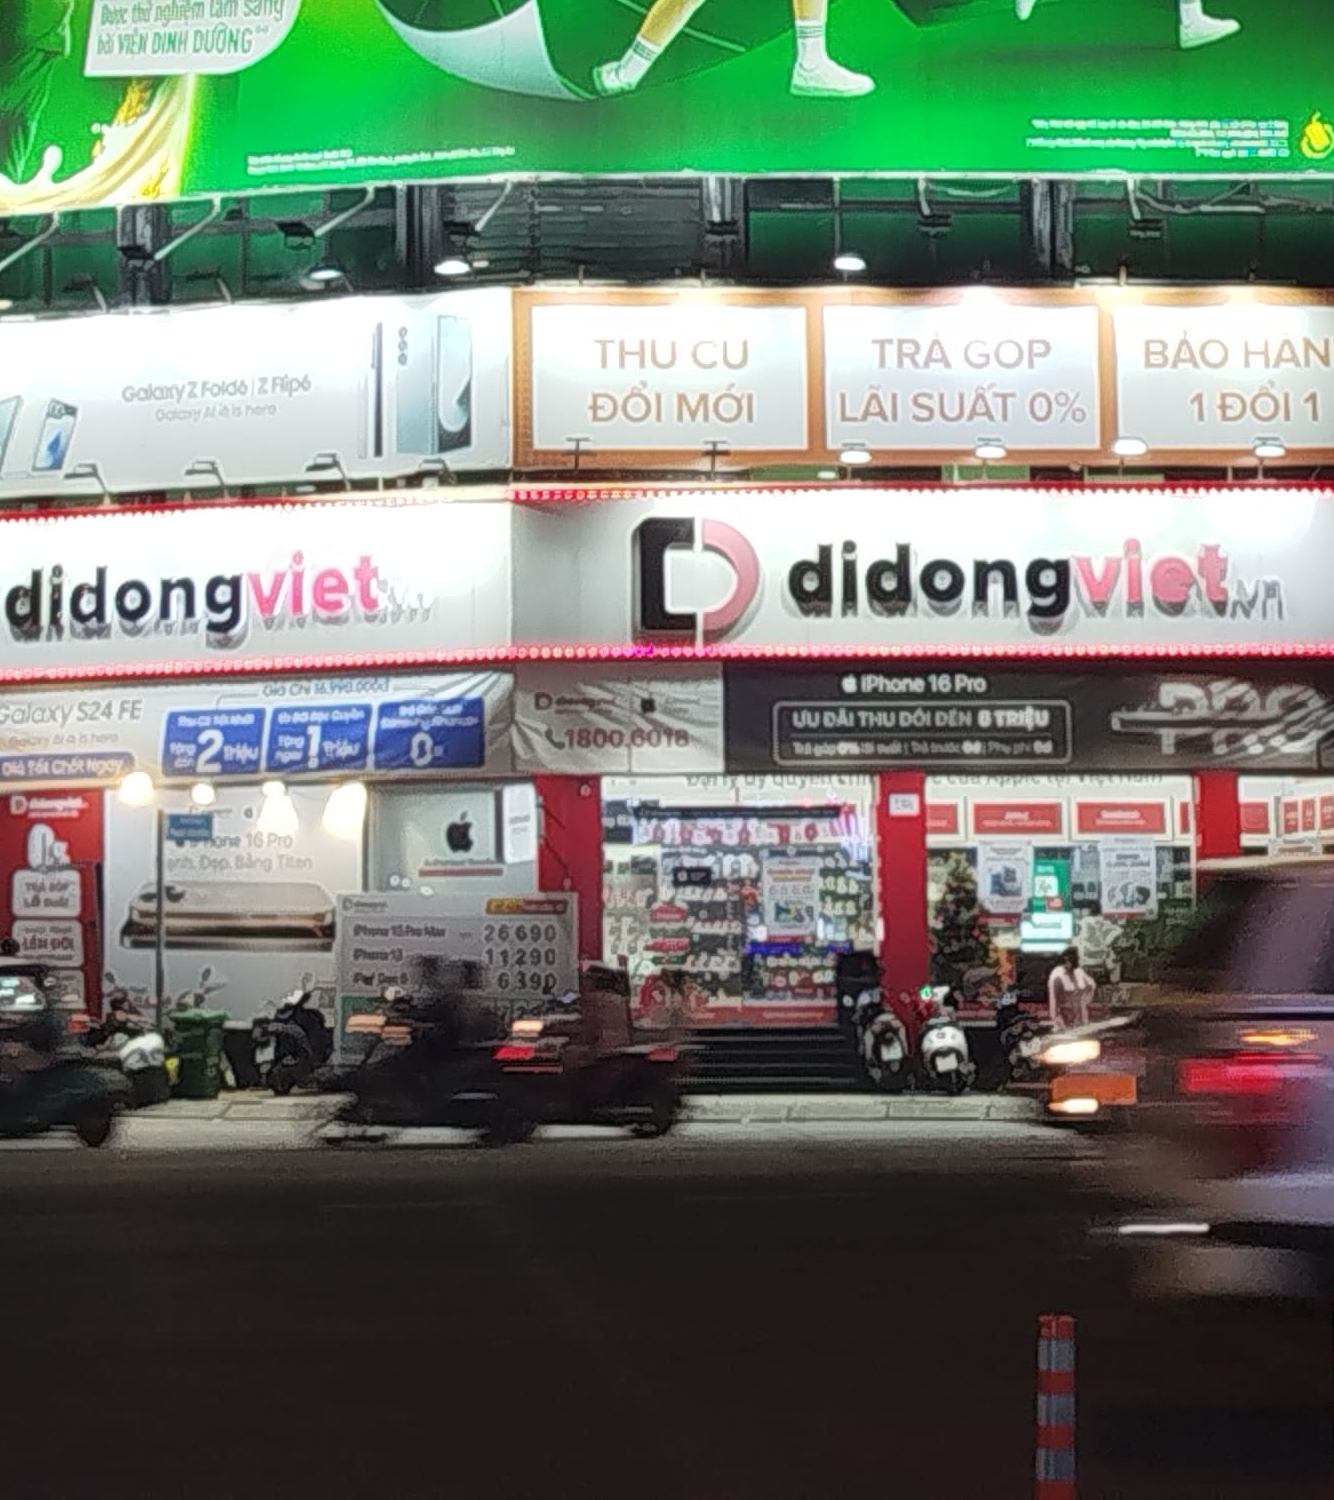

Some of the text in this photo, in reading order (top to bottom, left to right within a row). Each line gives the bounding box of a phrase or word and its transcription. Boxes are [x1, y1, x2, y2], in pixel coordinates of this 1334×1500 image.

[594, 339, 677, 370] THU
[122, 383, 185, 404] Galaxy
[187, 381, 198, 399] Z
[201, 379, 249, 397] Fold6
[271, 373, 312, 398] Flip6
[588, 380, 755, 424] ĐỔI MỚI
[838, 382, 1087, 424] LÃI SUẤT 0%
[1189, 379, 1320, 422] 1 ĐỔI 1
[861, 674, 987, 693] iPhone 16 Pro
[76, 700, 113, 721] S24
[118, 700, 142, 720] FE
[857, 709, 896, 728] THU
[993, 706, 1050, 731] TRIỆU
[196, 729, 224, 772] 2
[566, 729, 690, 749] 1800.6018
